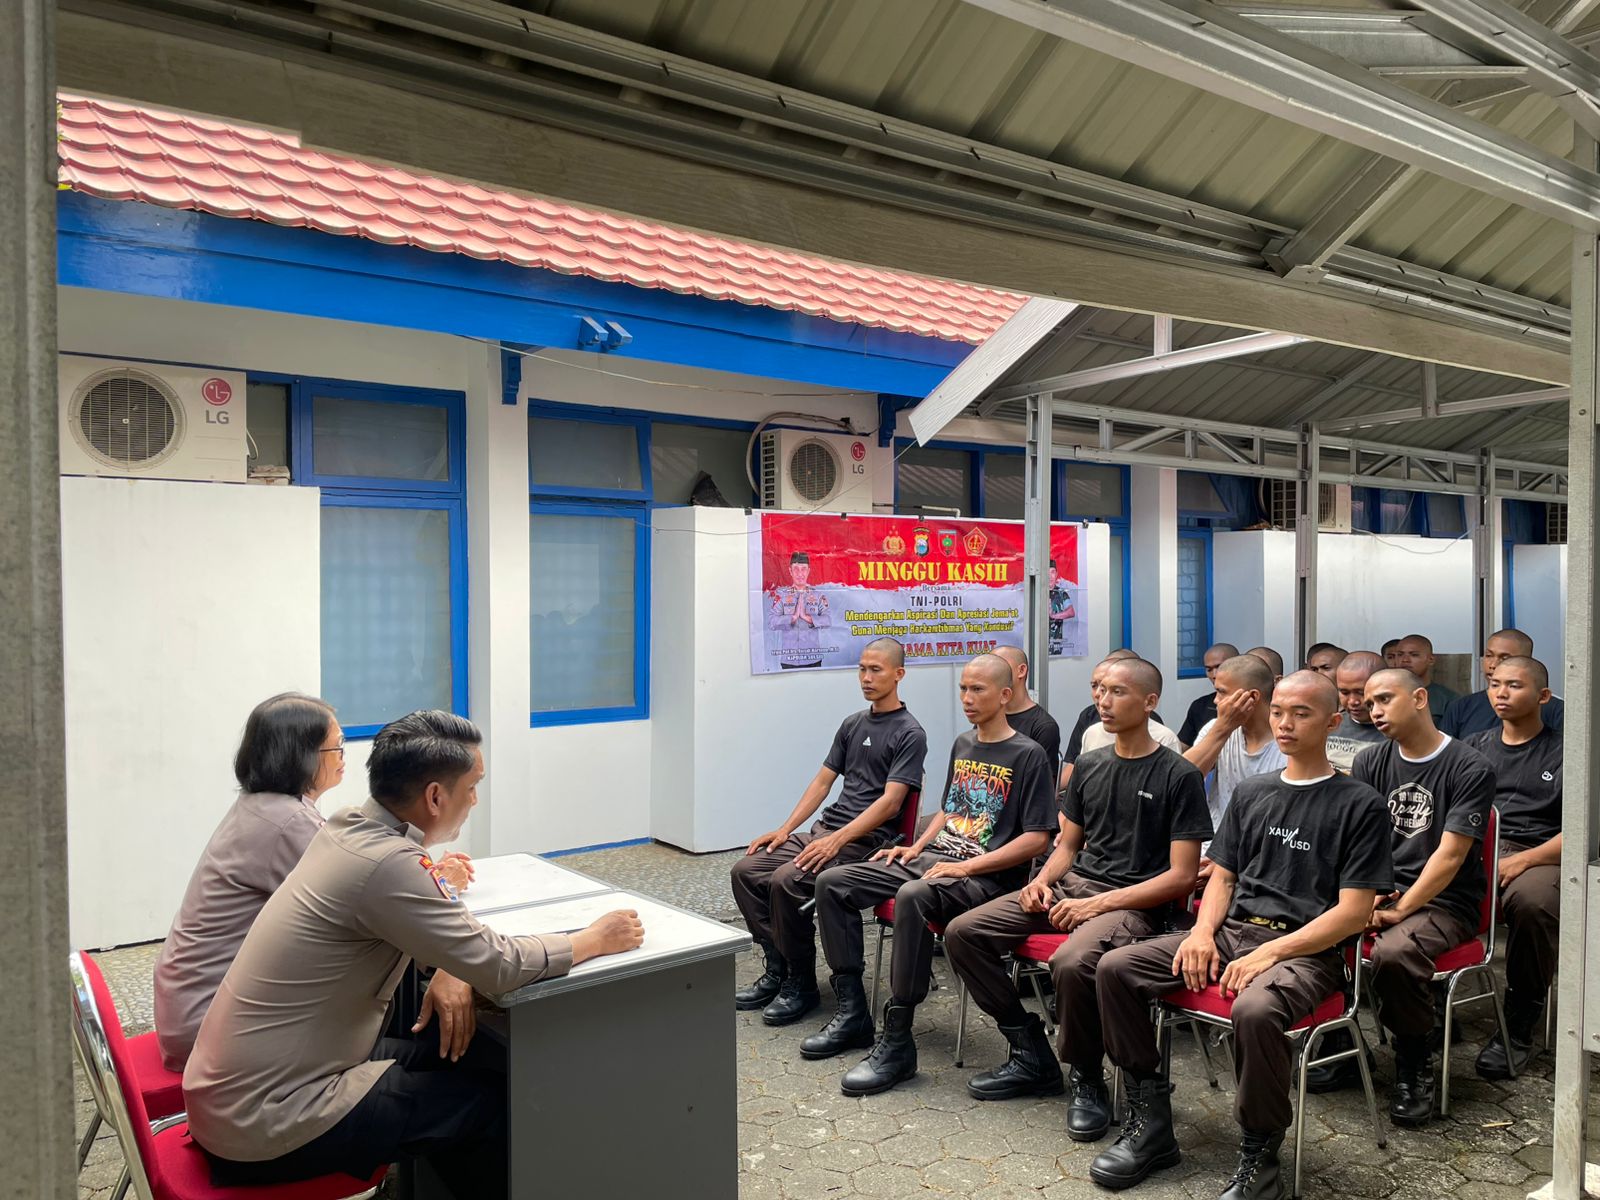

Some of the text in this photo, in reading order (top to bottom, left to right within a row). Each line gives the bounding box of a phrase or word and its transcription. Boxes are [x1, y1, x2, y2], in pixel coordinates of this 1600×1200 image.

[205, 409, 230, 425] LG
[852, 463, 865, 475] LG
[858, 560, 1008, 582] MINGGU KASIH
[910, 596, 963, 607] TNI-POLRI
[845, 608, 905, 622] Mendengarkan
[906, 608, 938, 621] Aspirasi
[939, 608, 955, 619] Dan
[957, 607, 990, 620] Apresiasi
[851, 624, 873, 637] Guna
[874, 623, 908, 638] Menjaga
[965, 622, 982, 635] Yang
[936, 641, 965, 657] KITA
[967, 639, 998, 655] KUAT
[971, 760, 989, 776] ME
[990, 764, 1013, 783] THE
[952, 768, 1012, 804] ORIZON
[1269, 826, 1311, 851] XAU USD
